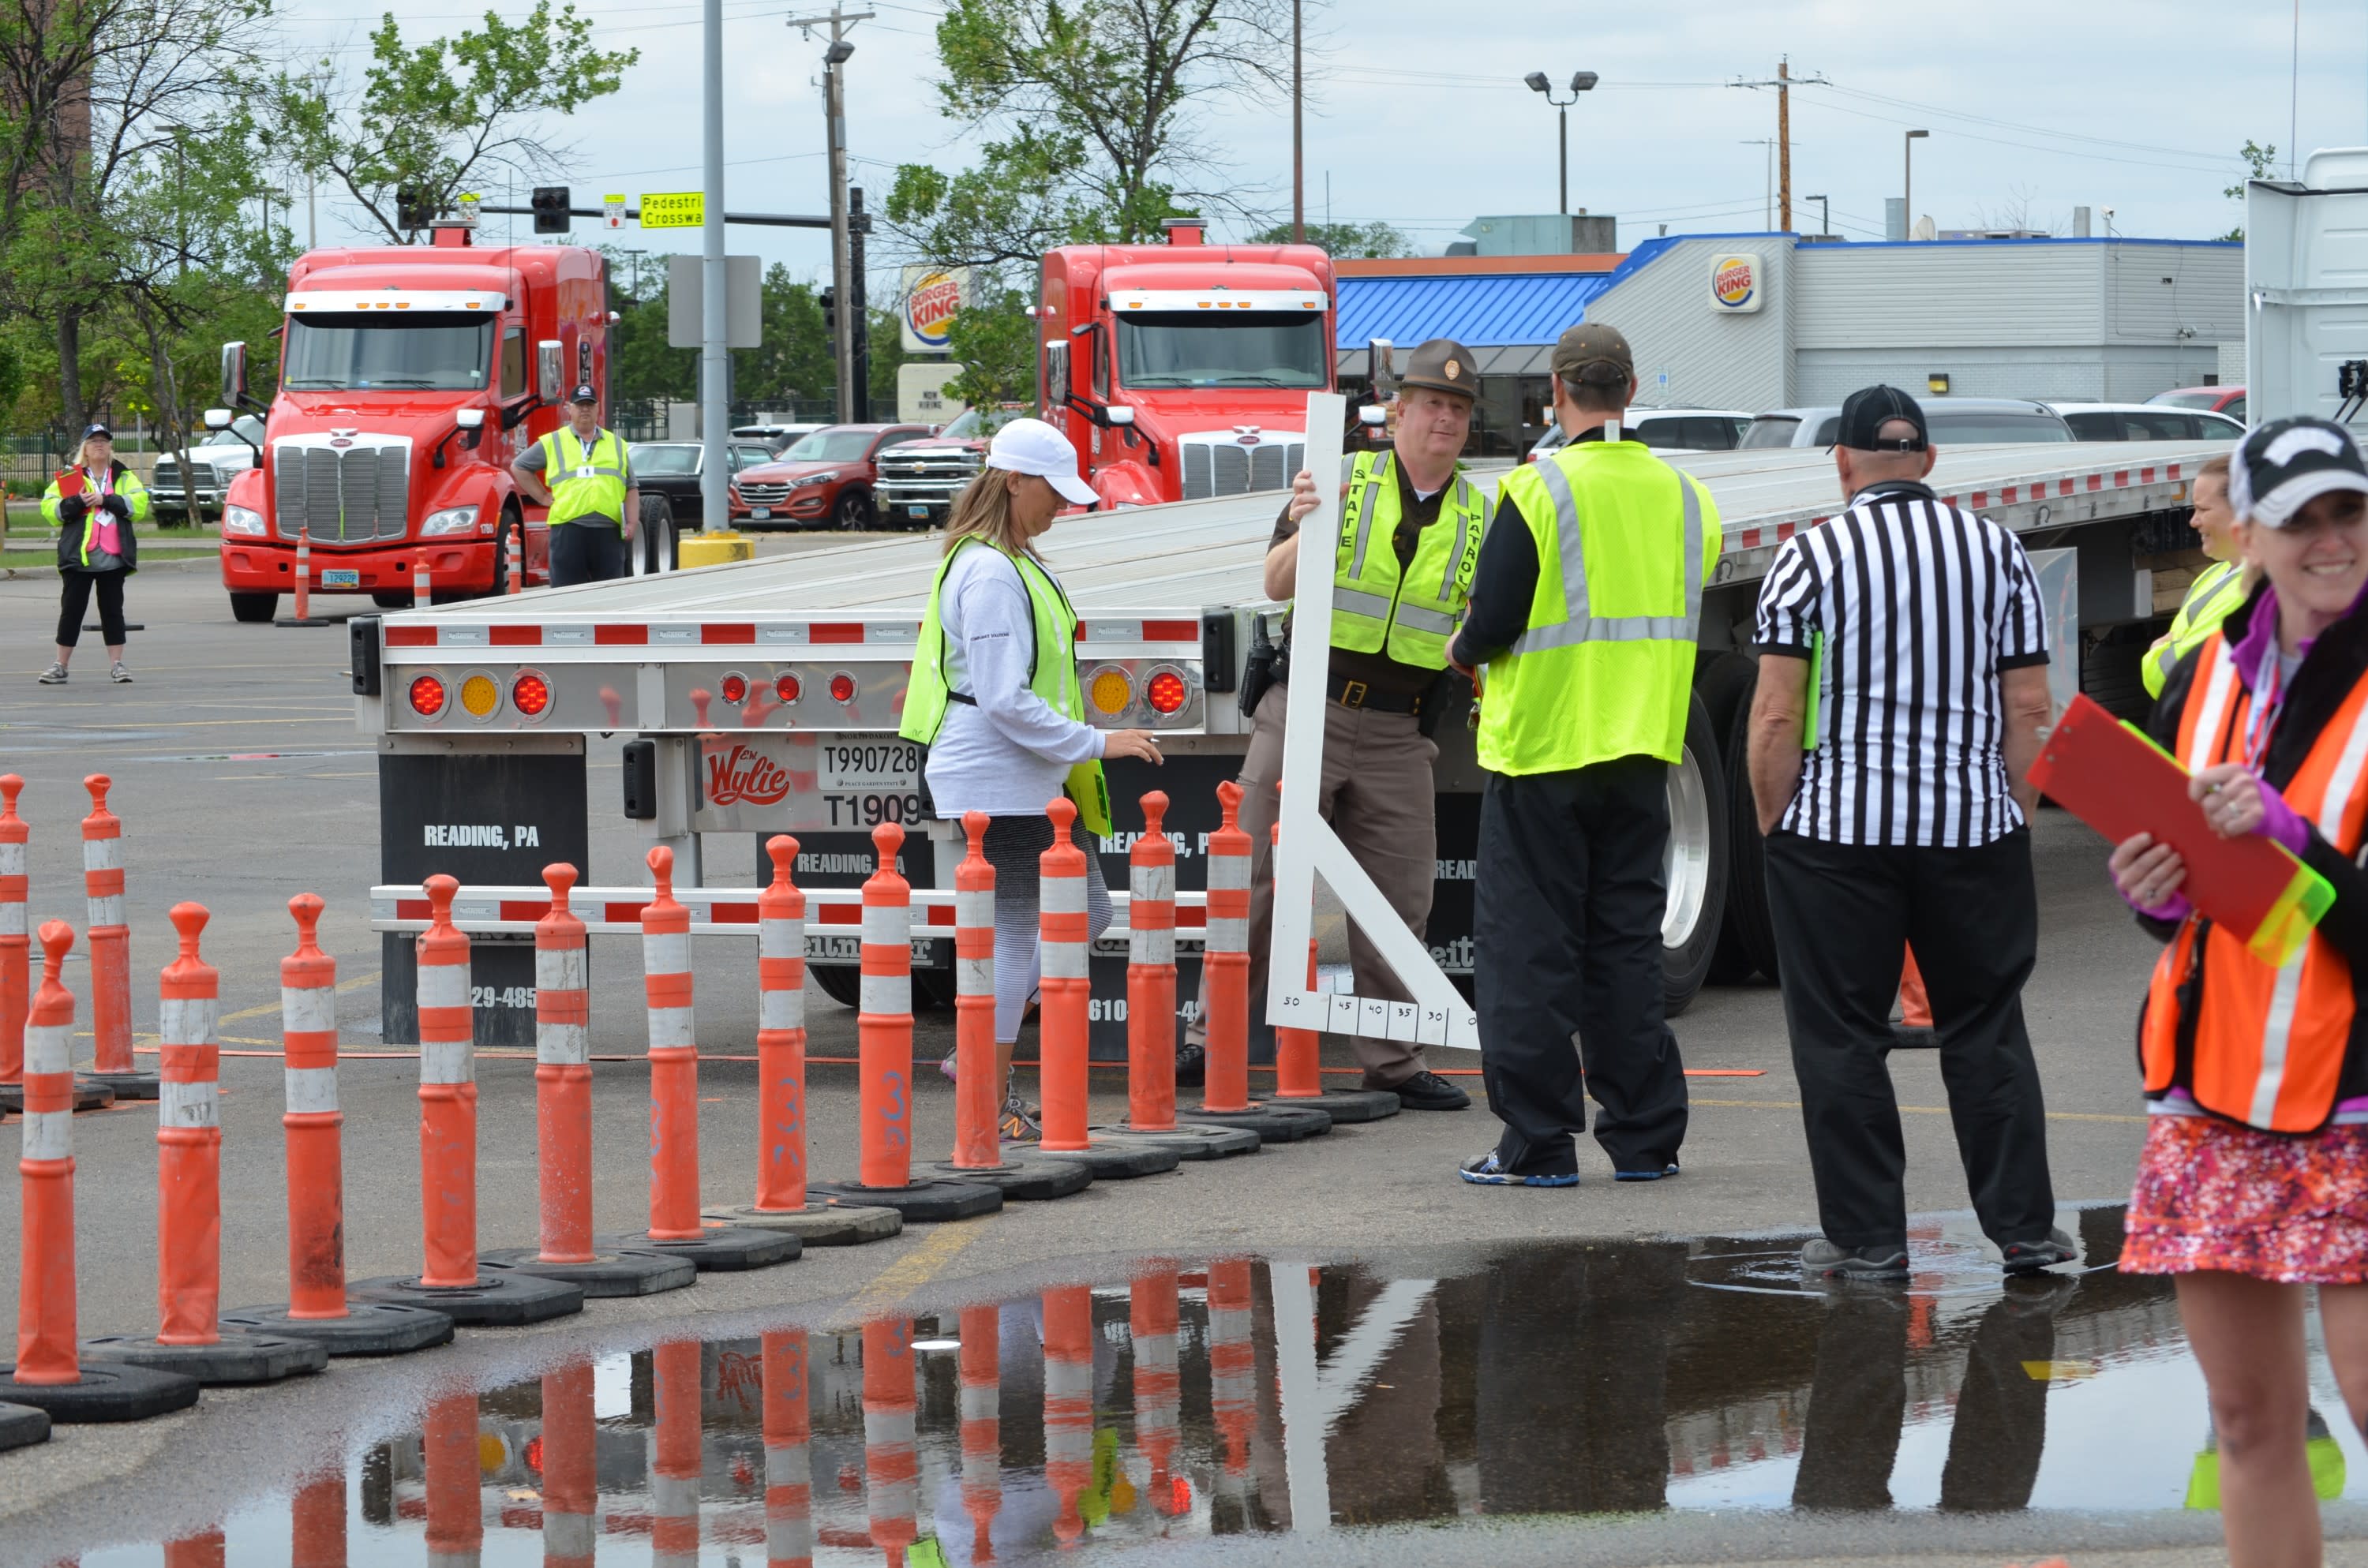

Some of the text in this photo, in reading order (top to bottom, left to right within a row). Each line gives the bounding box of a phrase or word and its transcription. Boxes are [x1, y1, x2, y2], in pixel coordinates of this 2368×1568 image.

[1716, 265, 1750, 283] BURGER
[1718, 275, 1752, 298] KING
[911, 281, 958, 310] BURGER
[913, 295, 961, 330] KING
[1340, 469, 1366, 548] STATE
[1458, 512, 1482, 586] PATROL
[824, 747, 917, 773] T990728
[708, 744, 790, 806] Wylie
[823, 794, 920, 826] T1909
[424, 825, 539, 851] READING, PA
[797, 853, 879, 875] READING,
[1283, 996, 1300, 1007] 50
[1339, 1001, 1352, 1010] 45
[1369, 1005, 1382, 1015] 40
[1397, 1008, 1412, 1018] 35
[1428, 1011, 1443, 1022] 30
